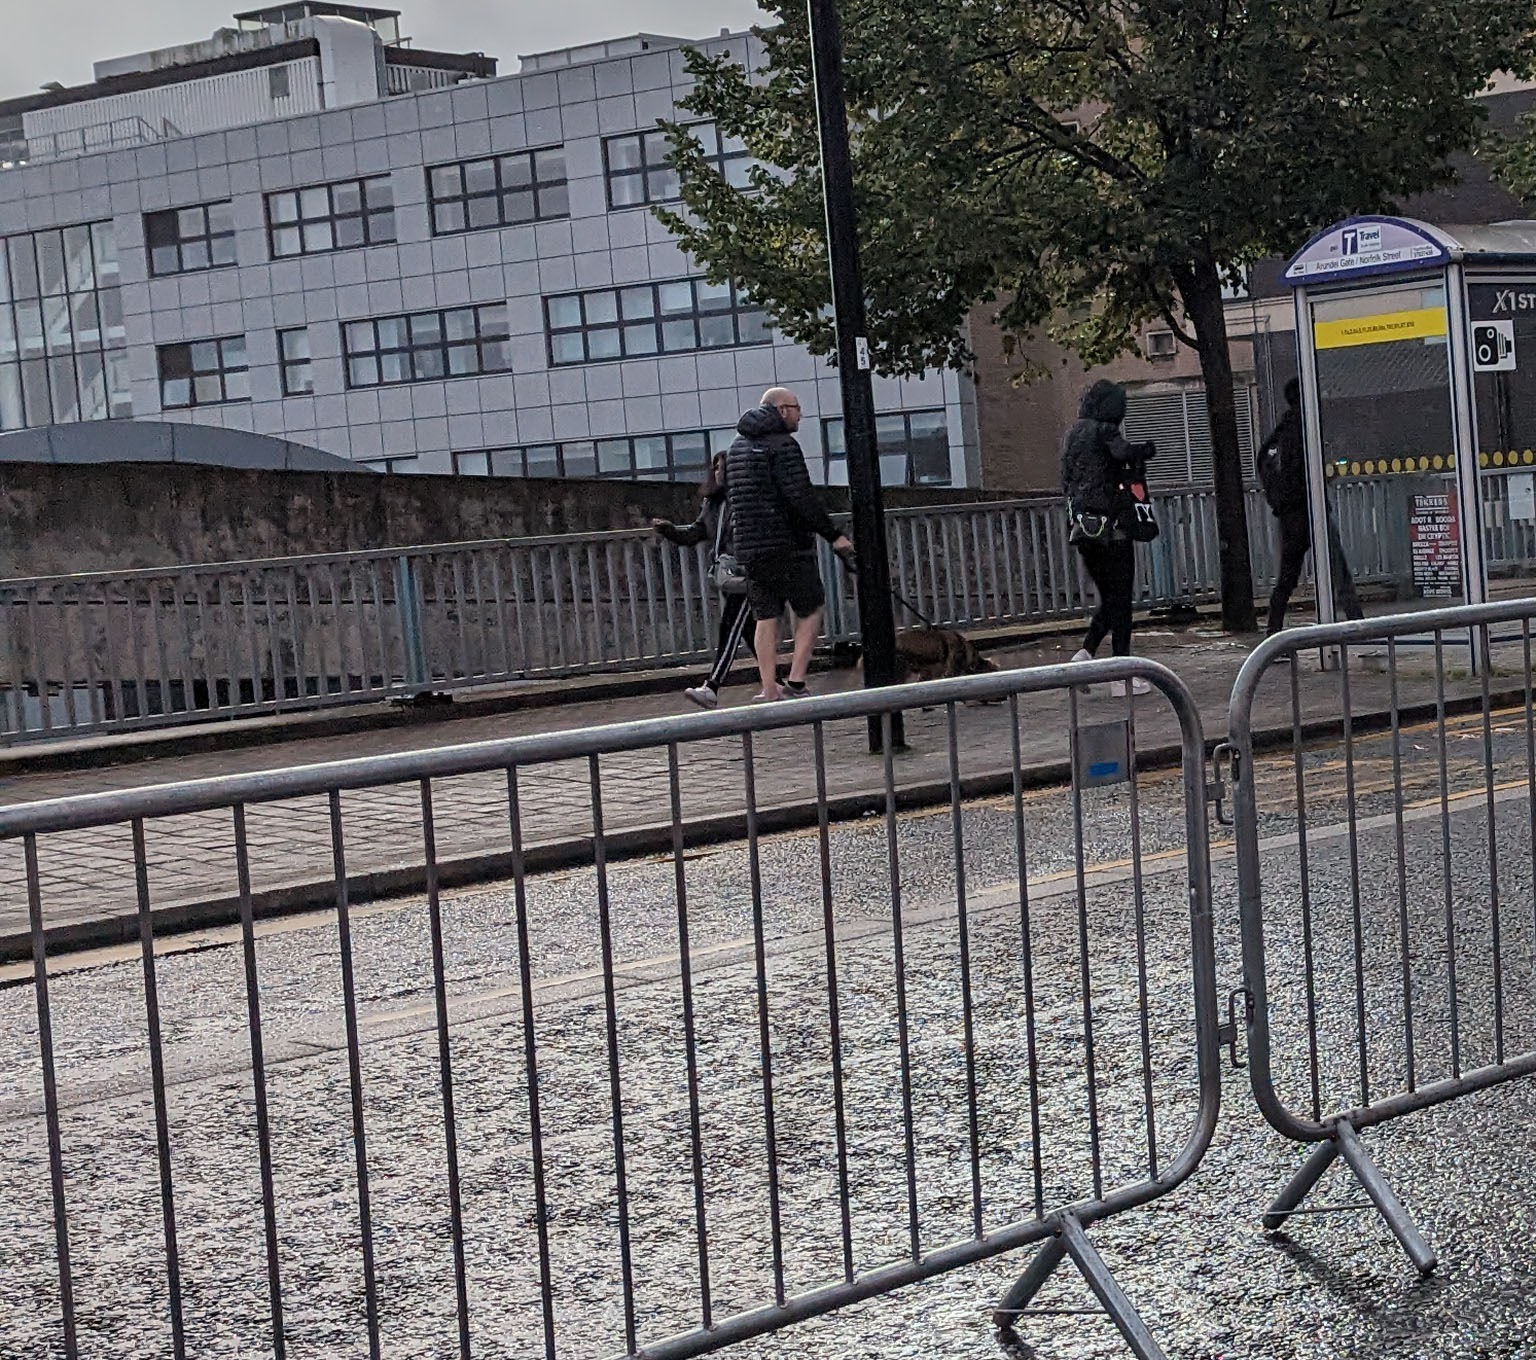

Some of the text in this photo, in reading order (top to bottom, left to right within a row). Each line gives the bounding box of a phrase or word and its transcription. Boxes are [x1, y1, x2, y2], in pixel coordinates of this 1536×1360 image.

[1359, 229, 1380, 241] Travel
[1340, 258, 1355, 267] Gate
[1382, 251, 1401, 261] Street
[1492, 290, 1516, 313] X1
